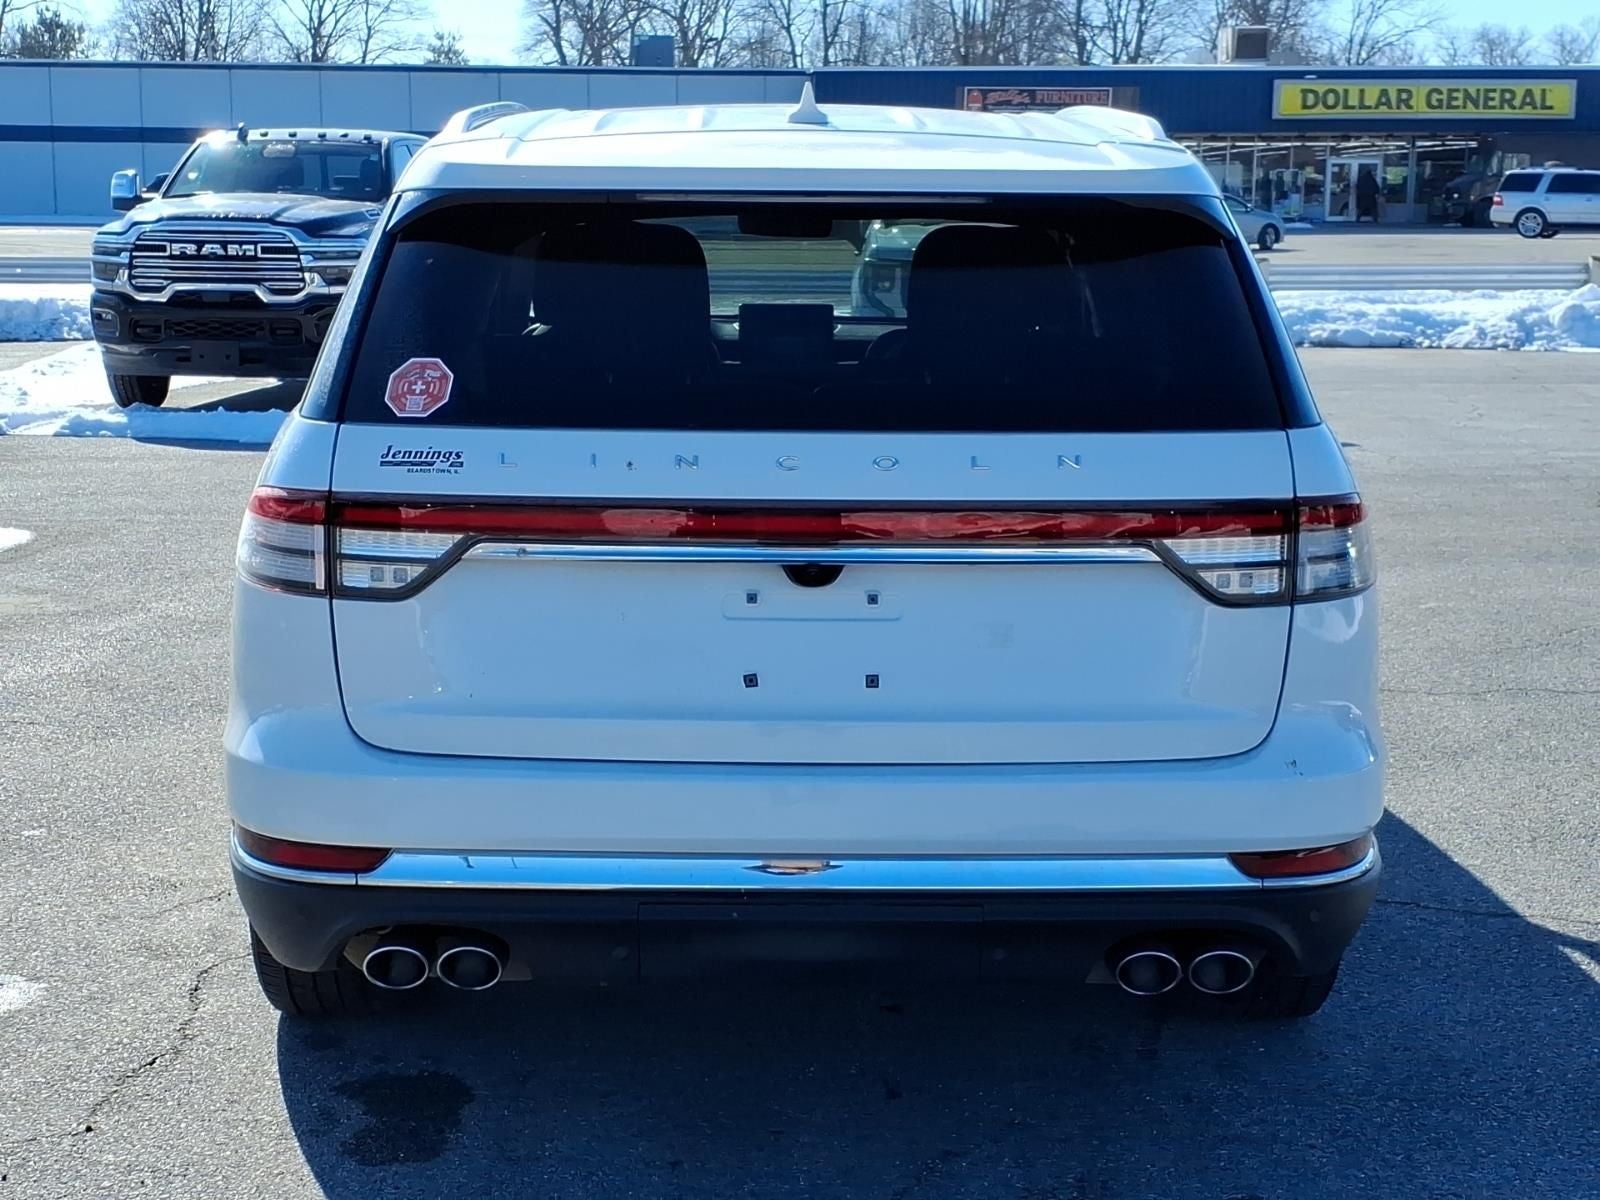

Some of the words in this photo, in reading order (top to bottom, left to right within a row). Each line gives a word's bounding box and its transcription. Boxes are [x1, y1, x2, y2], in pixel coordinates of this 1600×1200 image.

[1035, 92, 1108, 104] FURNITURE
[1300, 87, 1414, 110] DOLLAR
[1425, 87, 1555, 110] GENERAL
[171, 242, 255, 256] RAM
[380, 444, 464, 463] Jennings
[499, 453, 1081, 471] LINCOLN
